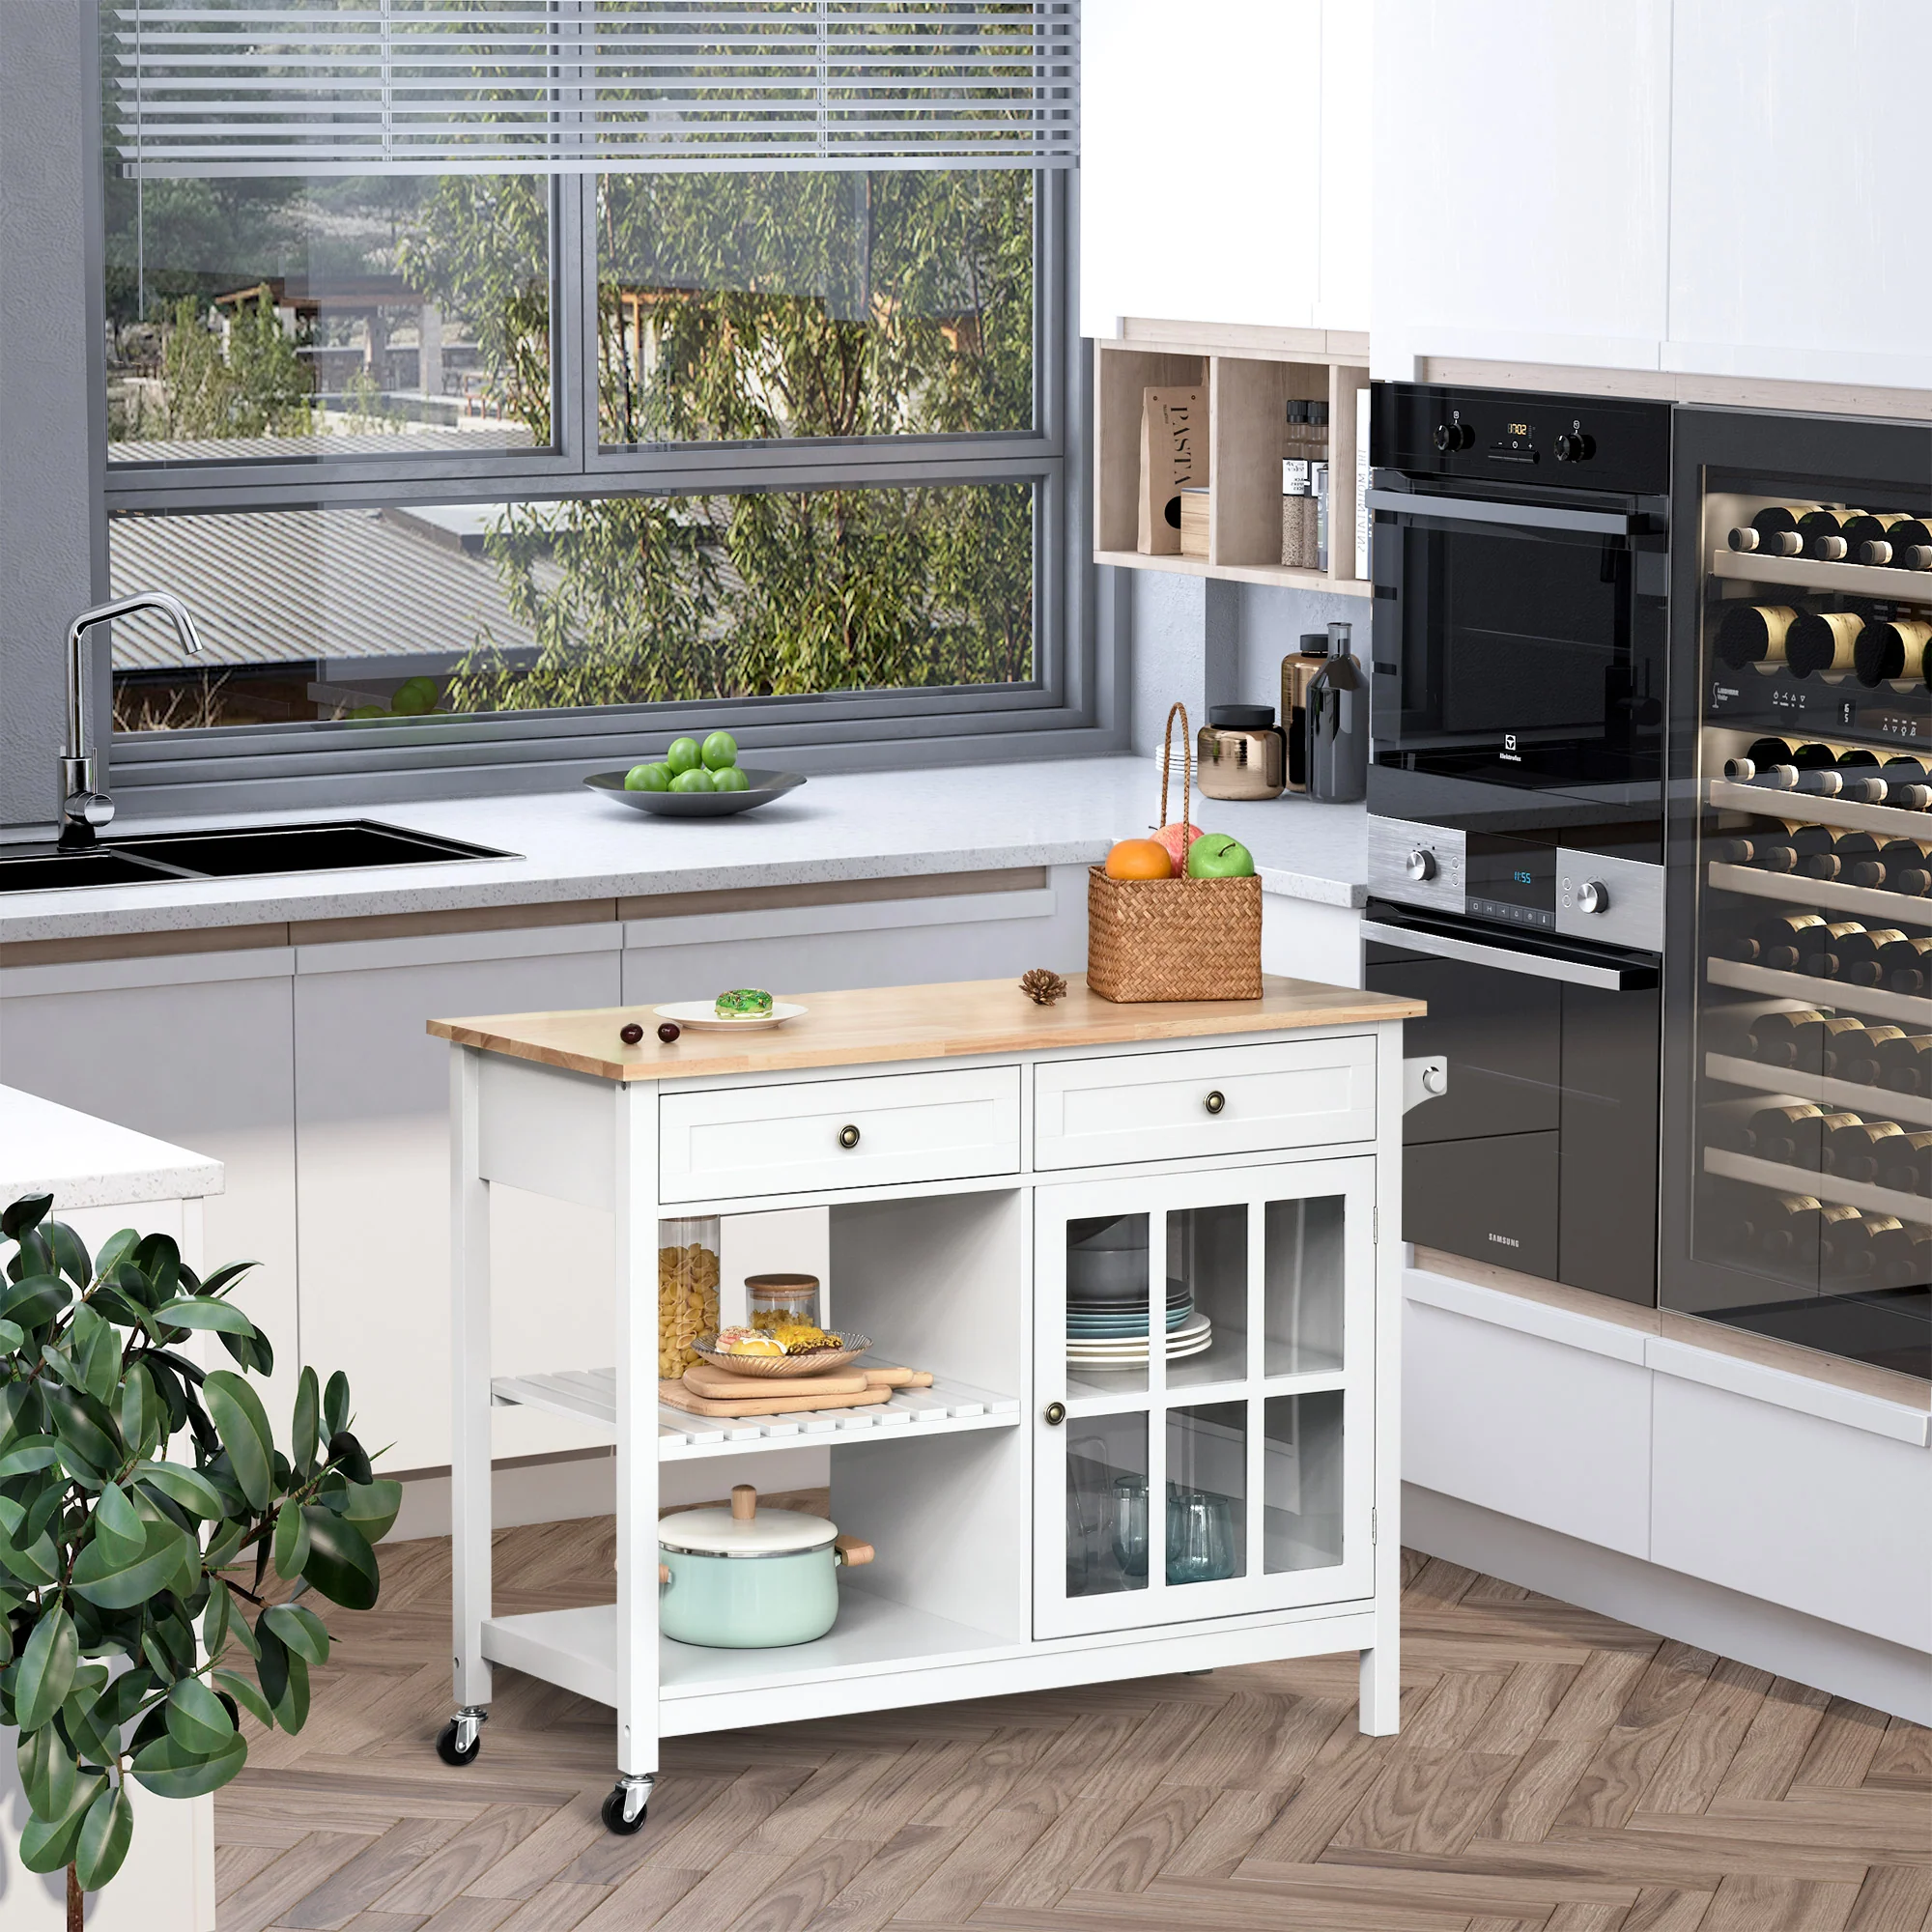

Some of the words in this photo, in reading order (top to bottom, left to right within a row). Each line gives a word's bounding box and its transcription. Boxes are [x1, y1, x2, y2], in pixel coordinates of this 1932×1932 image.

[1171, 407, 1193, 486] PASTA
[1514, 870, 1531, 884] 11:55
[1489, 1233, 1520, 1248] SAMSUNG
